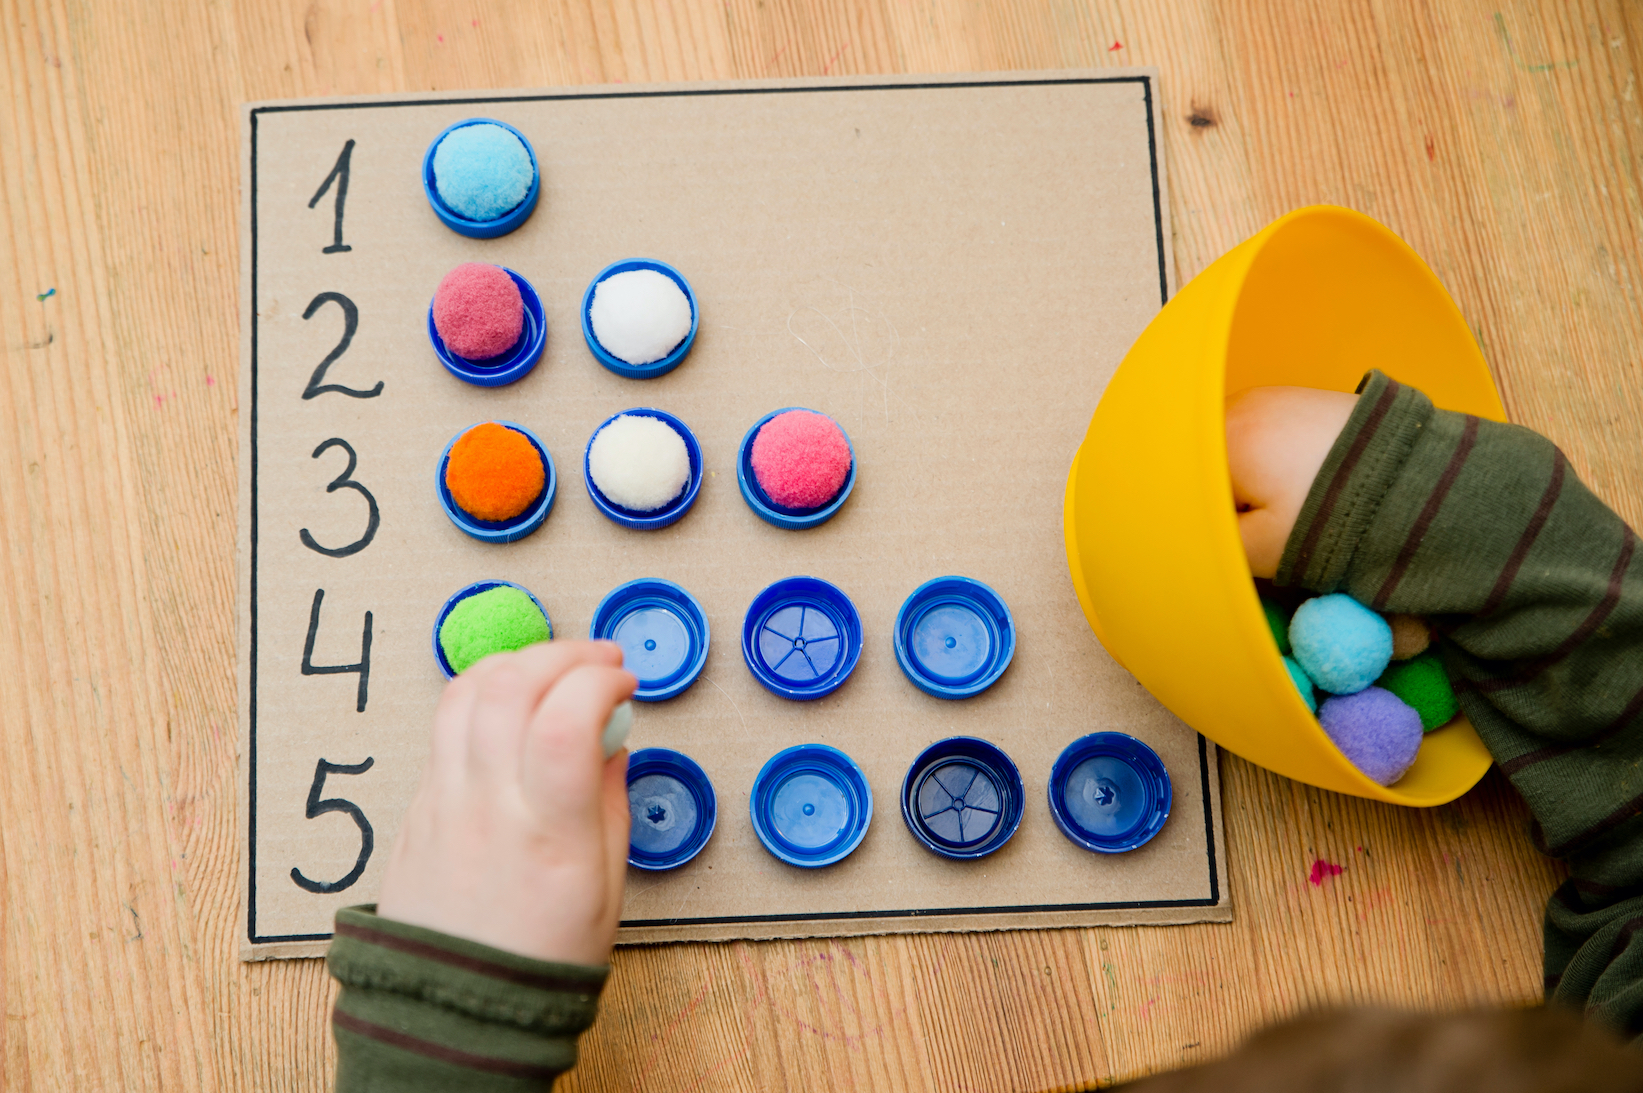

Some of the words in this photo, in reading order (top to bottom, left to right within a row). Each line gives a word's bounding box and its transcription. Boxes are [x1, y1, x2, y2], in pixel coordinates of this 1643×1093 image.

[308, 139, 356, 254] 1
[301, 291, 385, 400] 2
[299, 437, 380, 558] 3
[301, 588, 373, 713] 4
[290, 756, 375, 894] 5
